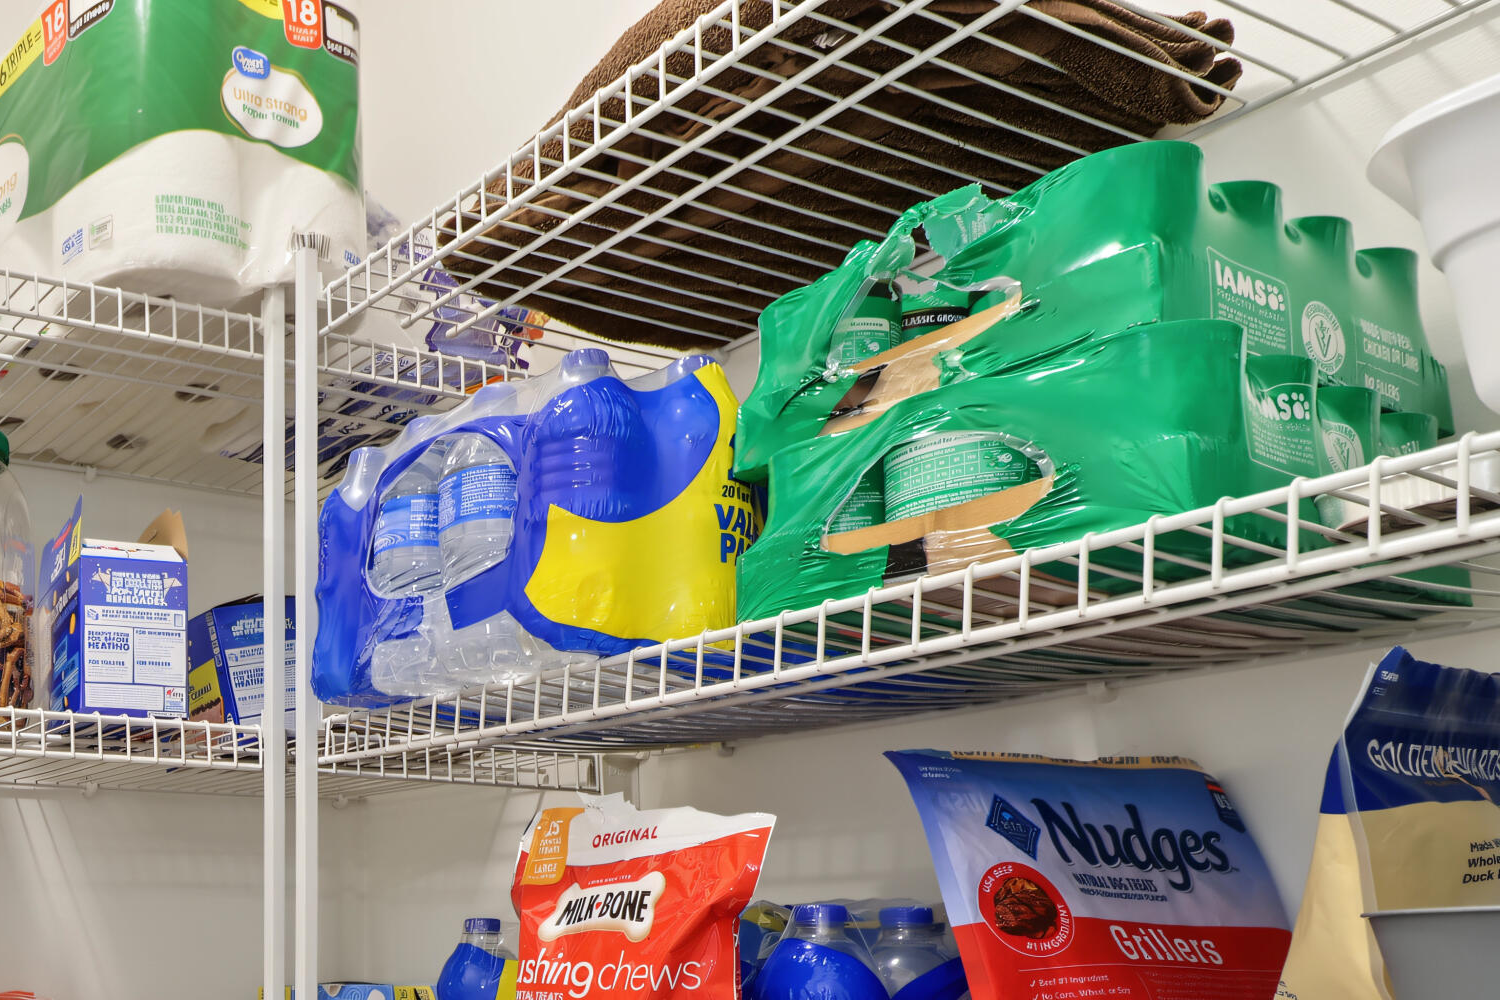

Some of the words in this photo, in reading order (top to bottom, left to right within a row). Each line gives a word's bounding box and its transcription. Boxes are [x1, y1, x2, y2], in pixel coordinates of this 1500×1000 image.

[45, 2, 65, 40] 18
[288, 0, 318, 25] 18
[0, 64, 7, 86] 6
[6, 31, 34, 74] TRIPLE
[1215, 260, 1267, 306] IAMS
[592, 825, 658, 848] ORIGINAL
[1030, 797, 1231, 892] Nudges
[1462, 871, 1494, 884] Duck
[555, 894, 599, 926] MILK
[598, 891, 651, 922] BONE
[1109, 925, 1223, 965] Grillers
[597, 950, 701, 991] chews
